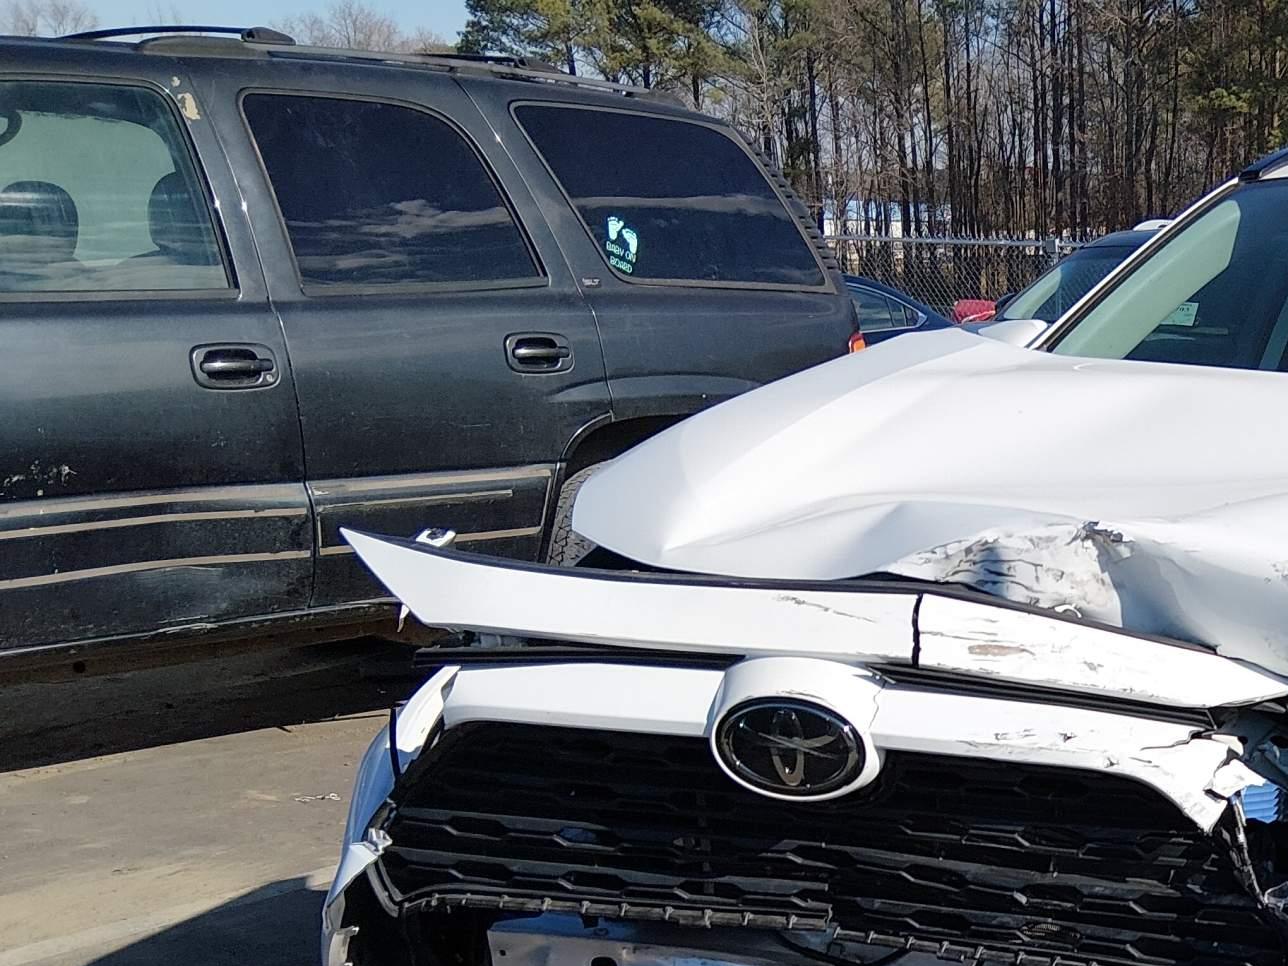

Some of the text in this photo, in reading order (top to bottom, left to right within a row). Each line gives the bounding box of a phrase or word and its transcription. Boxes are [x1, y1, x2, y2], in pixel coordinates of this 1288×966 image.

[606, 241, 636, 263] BABY ON
[609, 255, 632, 273] BOARD
